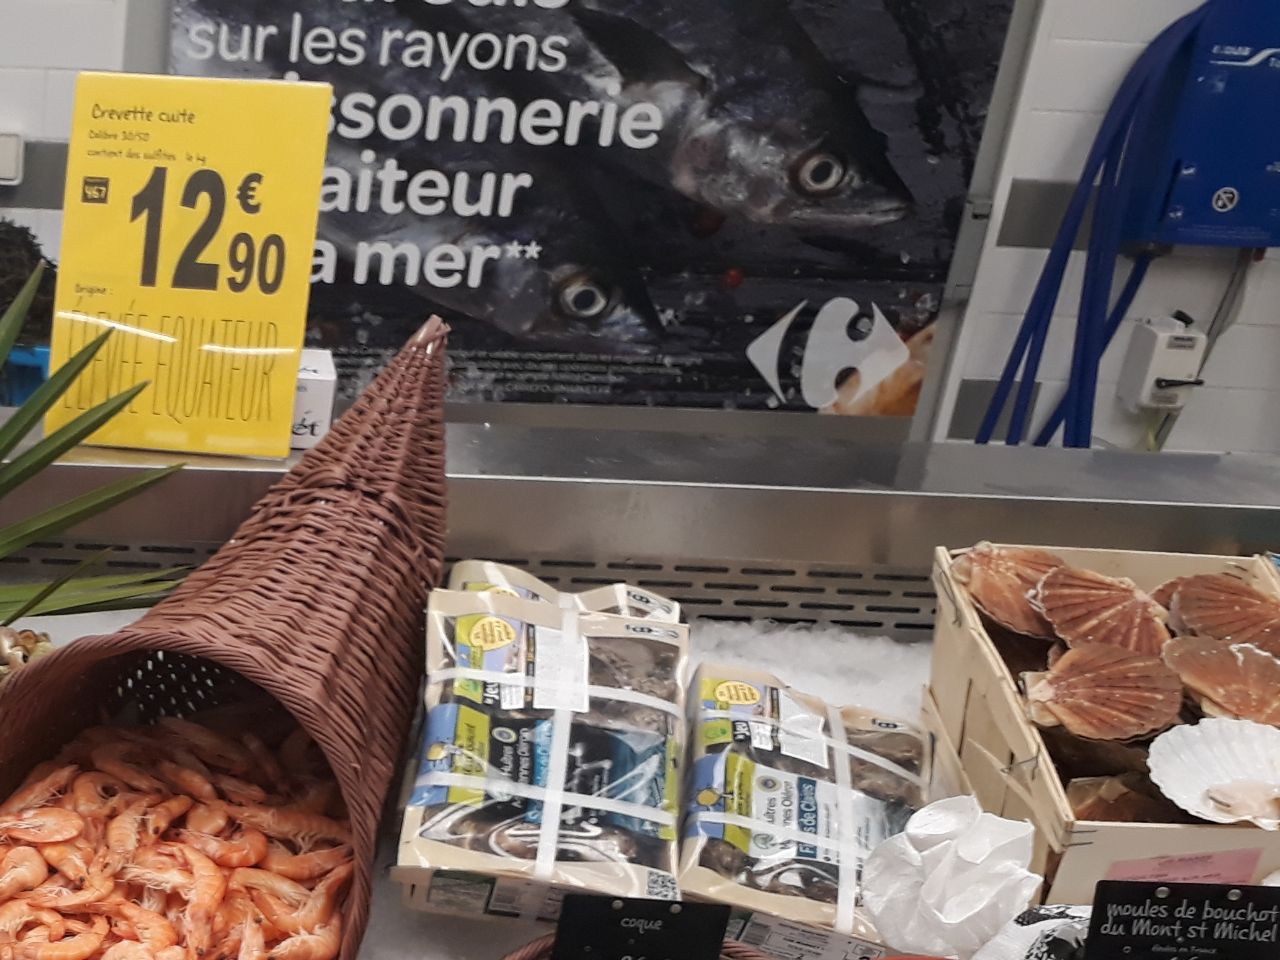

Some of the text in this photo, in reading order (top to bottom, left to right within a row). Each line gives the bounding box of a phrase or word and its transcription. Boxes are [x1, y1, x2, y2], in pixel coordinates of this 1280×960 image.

[186, 12, 572, 83] sur les rayons
[91, 103, 196, 124] Crevette cuite
[324, 85, 665, 150] sonnerie
[319, 149, 534, 220] aiteur
[129, 166, 227, 291] 12
[227, 232, 286, 296] 90
[142, 315, 278, 424] EQUATEUR
[620, 917, 663, 935] coque
[1100, 915, 1279, 942] du Mont st Michel
[1106, 899, 1280, 923] moules de bouchot
